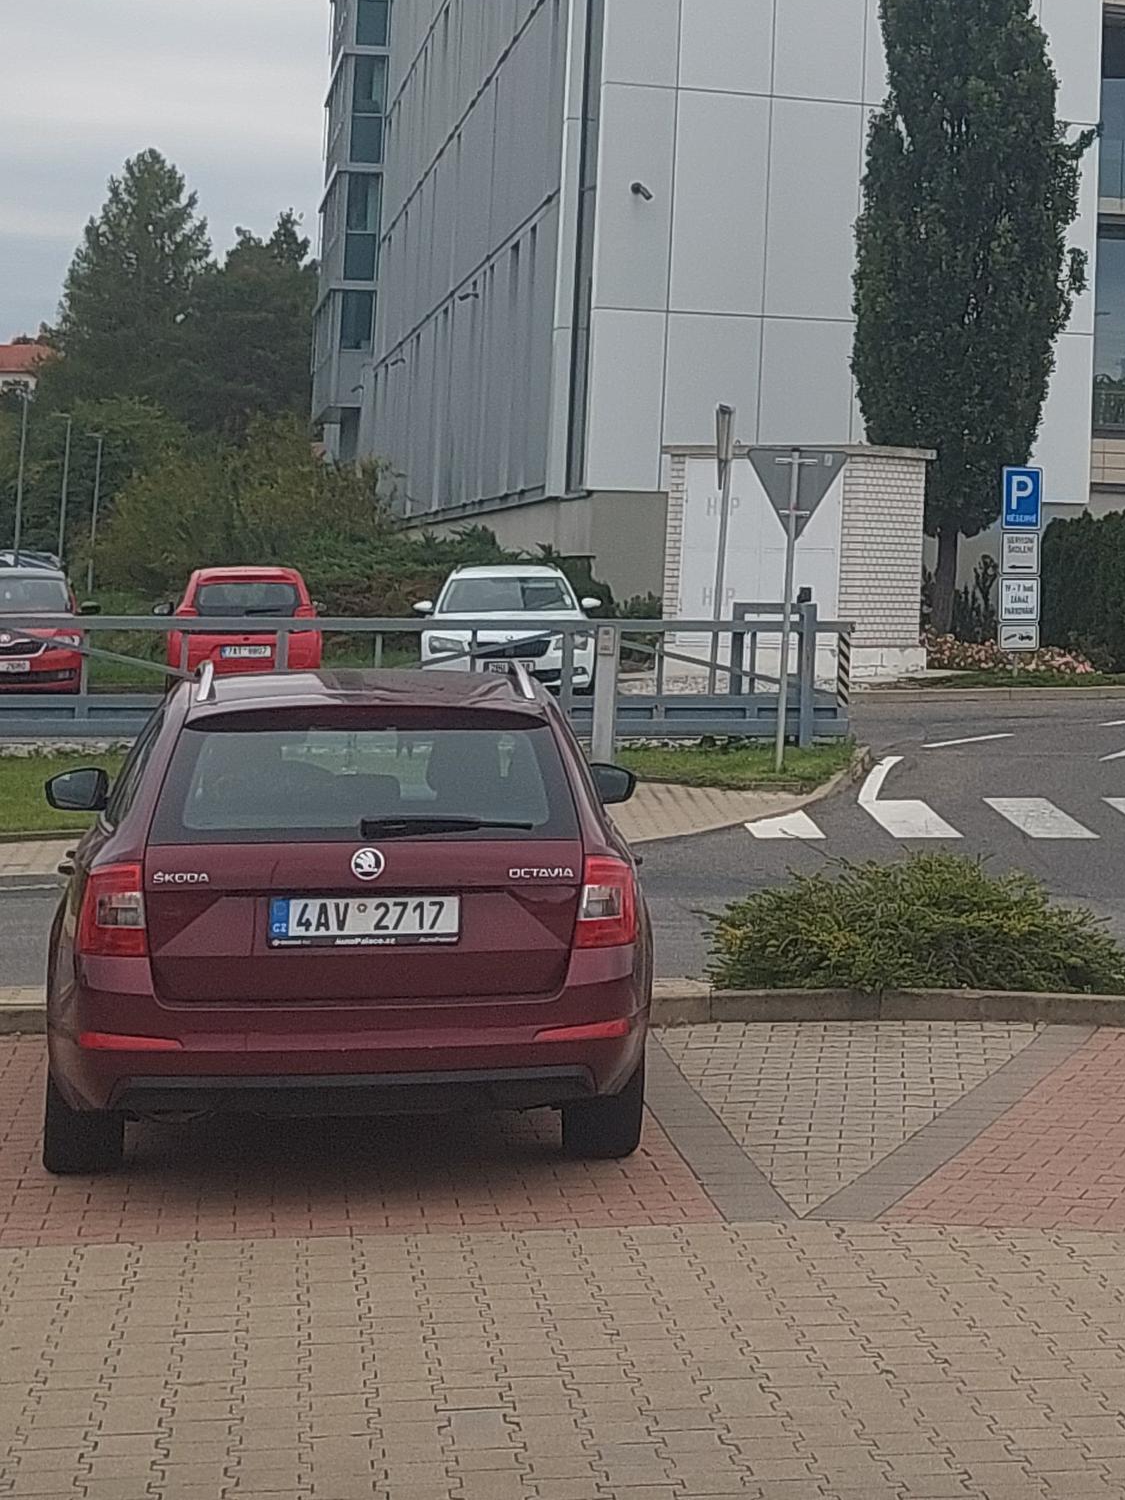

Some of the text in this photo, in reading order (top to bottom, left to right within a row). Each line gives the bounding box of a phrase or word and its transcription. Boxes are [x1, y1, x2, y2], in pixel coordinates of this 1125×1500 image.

[1011, 475, 1033, 510] P
[706, 497, 740, 516] HP
[702, 587, 735, 607] HP
[152, 871, 210, 884] ŠKODA
[508, 867, 574, 879] OCTAVIA
[296, 901, 445, 932] 4AV 2717
